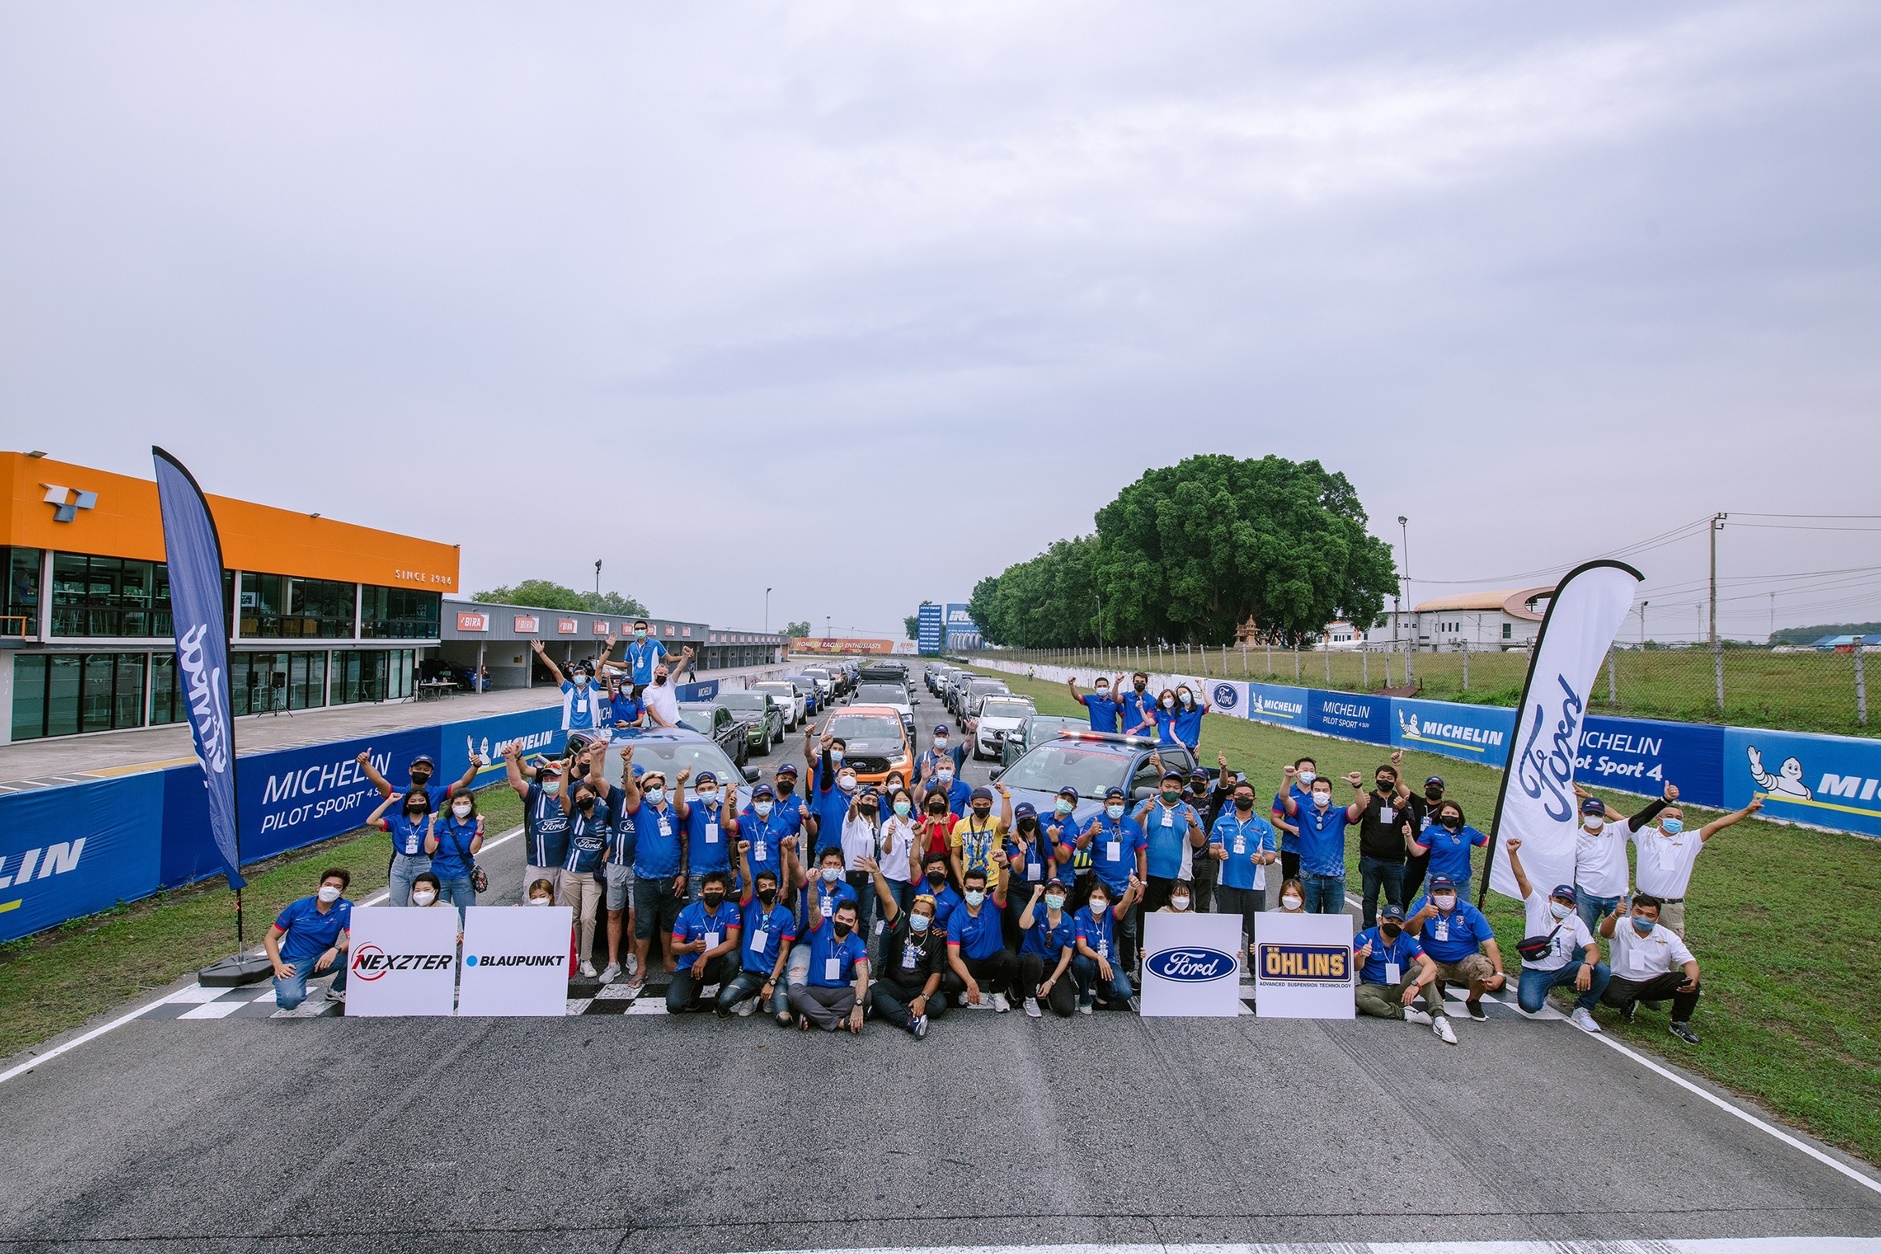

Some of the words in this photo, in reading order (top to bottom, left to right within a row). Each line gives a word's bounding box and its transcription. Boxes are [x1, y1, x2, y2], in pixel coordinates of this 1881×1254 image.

[395, 569, 426, 582] SINCE
[431, 574, 452, 585] 1986
[464, 617, 481, 627] BIRA
[519, 620, 533, 629] BIRA
[844, 641, 882, 649] ENTHUSIASTS
[1218, 686, 1234, 705] Ford
[1263, 699, 1303, 714] MICHELIN
[1322, 701, 1370, 719] MICHELIN
[1322, 716, 1339, 725] PILOT
[1338, 719, 1358, 729] SPORT
[1422, 721, 1504, 746] MICHELIN
[493, 730, 553, 760] MHELIN
[1518, 673, 1582, 822] Ford
[1595, 755, 1645, 778] Sport
[1646, 763, 1663, 782] 4
[1817, 773, 1881, 801] MI
[260, 804, 314, 834] PILOT
[313, 790, 365, 819] SPORT
[366, 787, 373, 798] 4
[541, 819, 568, 832] Ford
[578, 838, 603, 850] Ford
[352, 954, 453, 970] NEXZTER
[479, 955, 565, 967] BLAUPUNKT
[1163, 951, 1220, 977] Ford
[1265, 946, 1345, 977] ÖHLINS
